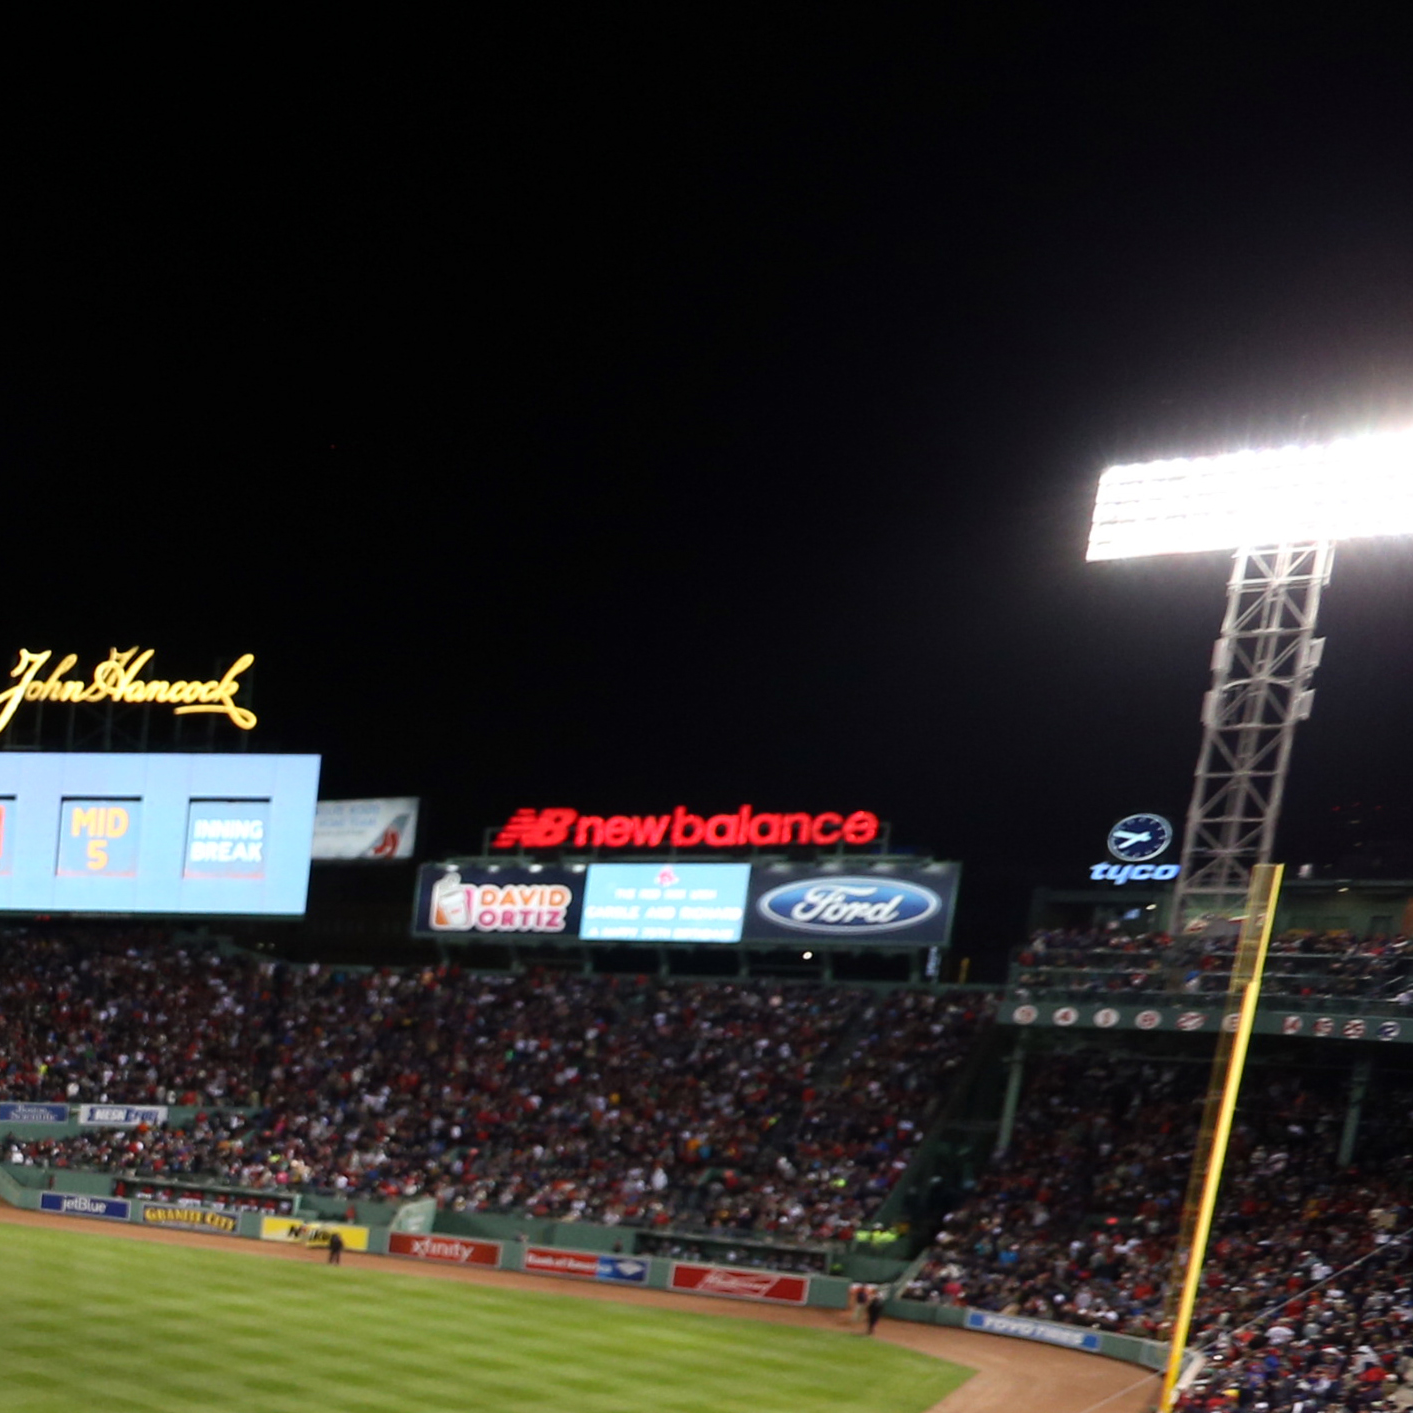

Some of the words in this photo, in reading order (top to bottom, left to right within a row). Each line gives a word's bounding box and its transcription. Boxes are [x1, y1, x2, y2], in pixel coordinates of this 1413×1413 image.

[87, 646, 257, 730] Hancock
[71, 807, 129, 837] MID
[193, 819, 263, 839] INNING
[86, 839, 108, 870] 5
[190, 841, 262, 862] BREAK
[1089, 861, 1182, 885] tyco
[480, 888, 566, 908] DAVID
[791, 885, 904, 923] Ford
[478, 909, 566, 928] ORTIZ
[62, 1196, 107, 1213] jetBlue
[144, 1206, 203, 1224] GRANITE
[205, 1211, 237, 1232] CITY
[412, 1237, 474, 1262] xfinity
[526, 1252, 553, 1266] Bank
[567, 1257, 613, 1275] America
